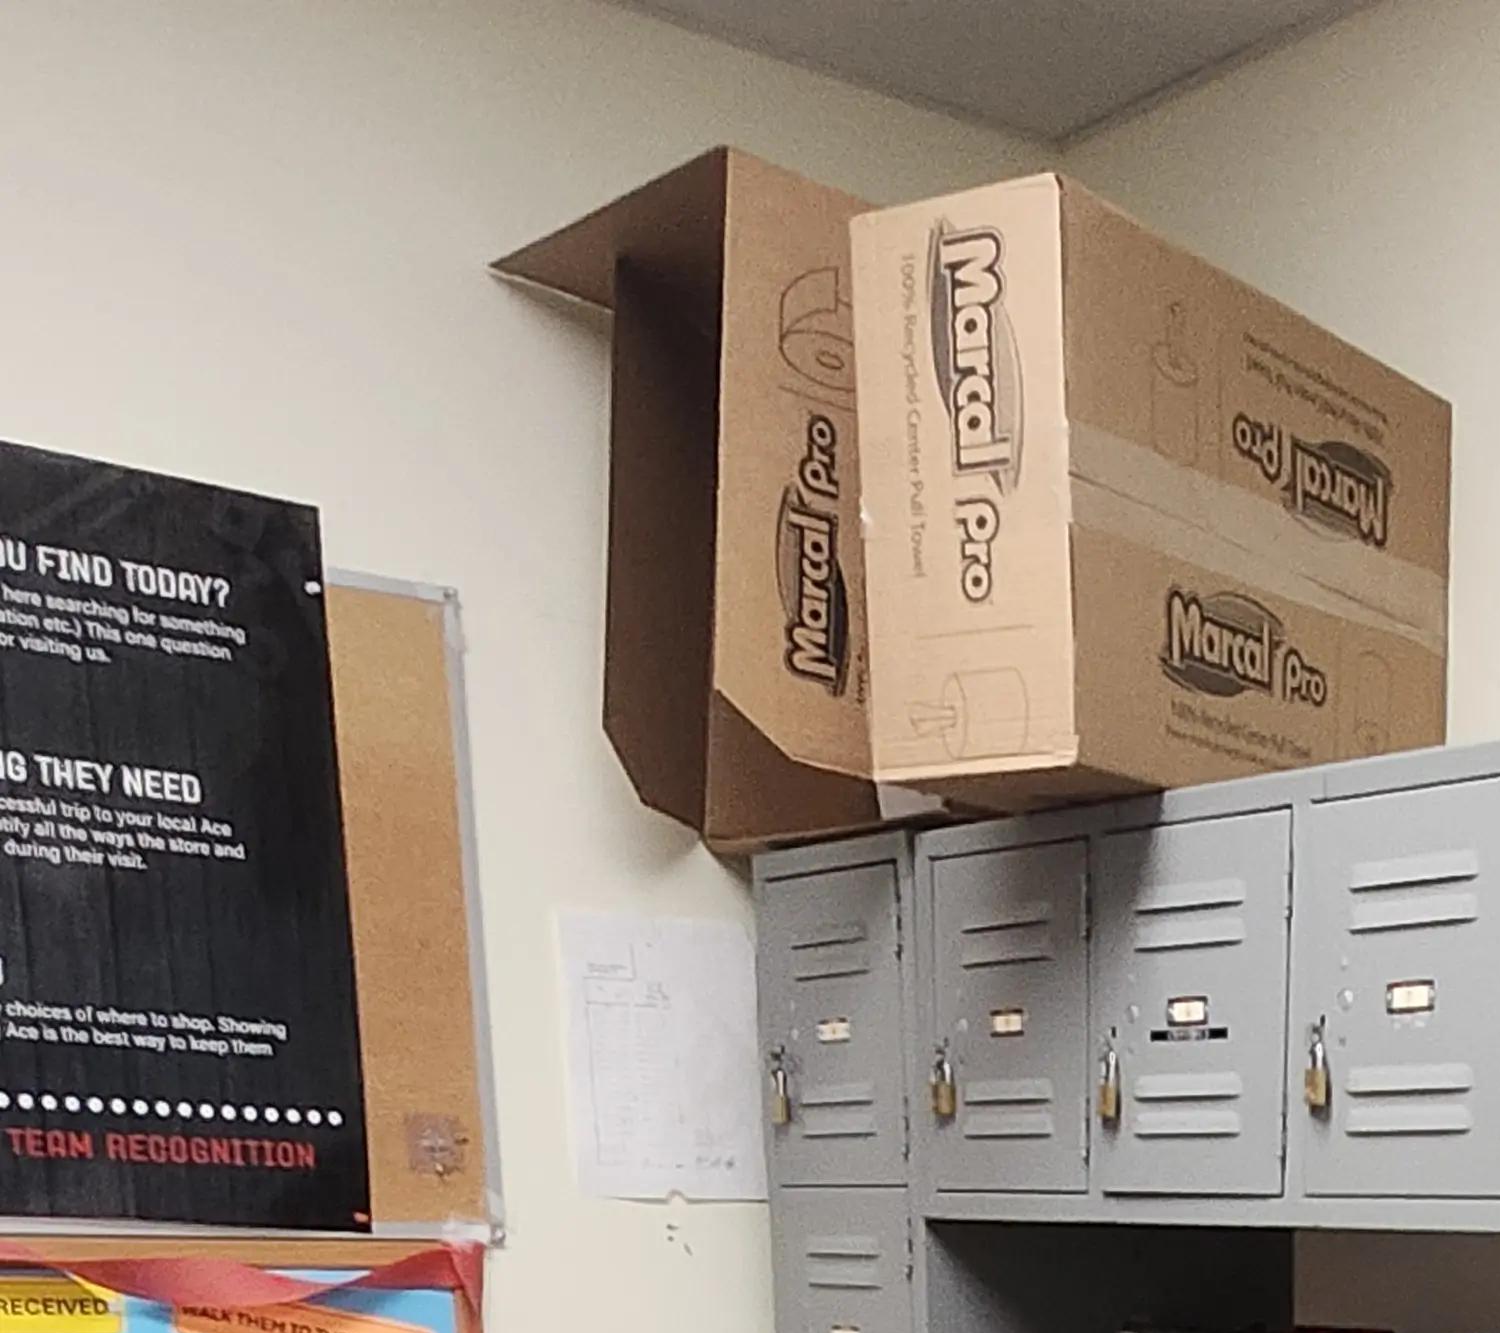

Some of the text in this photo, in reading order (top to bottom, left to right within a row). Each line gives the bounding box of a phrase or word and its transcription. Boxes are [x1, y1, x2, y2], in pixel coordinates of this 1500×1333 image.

[941, 231, 1012, 602] Marcal Pro
[1233, 413, 1388, 547] Marcal Pro
[786, 414, 839, 686] Marcal Pro
[0, 537, 230, 608] U FIND TODAY?
[46, 594, 130, 626] searching
[132, 604, 157, 626] for
[159, 614, 247, 646] something
[85, 619, 122, 644] This
[124, 629, 158, 649] one
[160, 636, 232, 661] question
[18, 634, 83, 662] visiting
[1168, 590, 1327, 707] Marcal Pro
[33, 753, 113, 794] THEY
[121, 764, 201, 804] NEED
[60, 800, 232, 837] trip to your local Ace
[4, 839, 148, 870] during their visit.
[33, 819, 246, 860] all the ways the store and
[5, 1000, 288, 1041] choices of where to shop. Showing
[5, 1022, 275, 1057] Ace is the best way to keep them
[4, 1127, 316, 1168] TEAM RECOGNITION
[0, 1296, 109, 1317] RECEIVED
[236, 1312, 286, 1333] THEM
